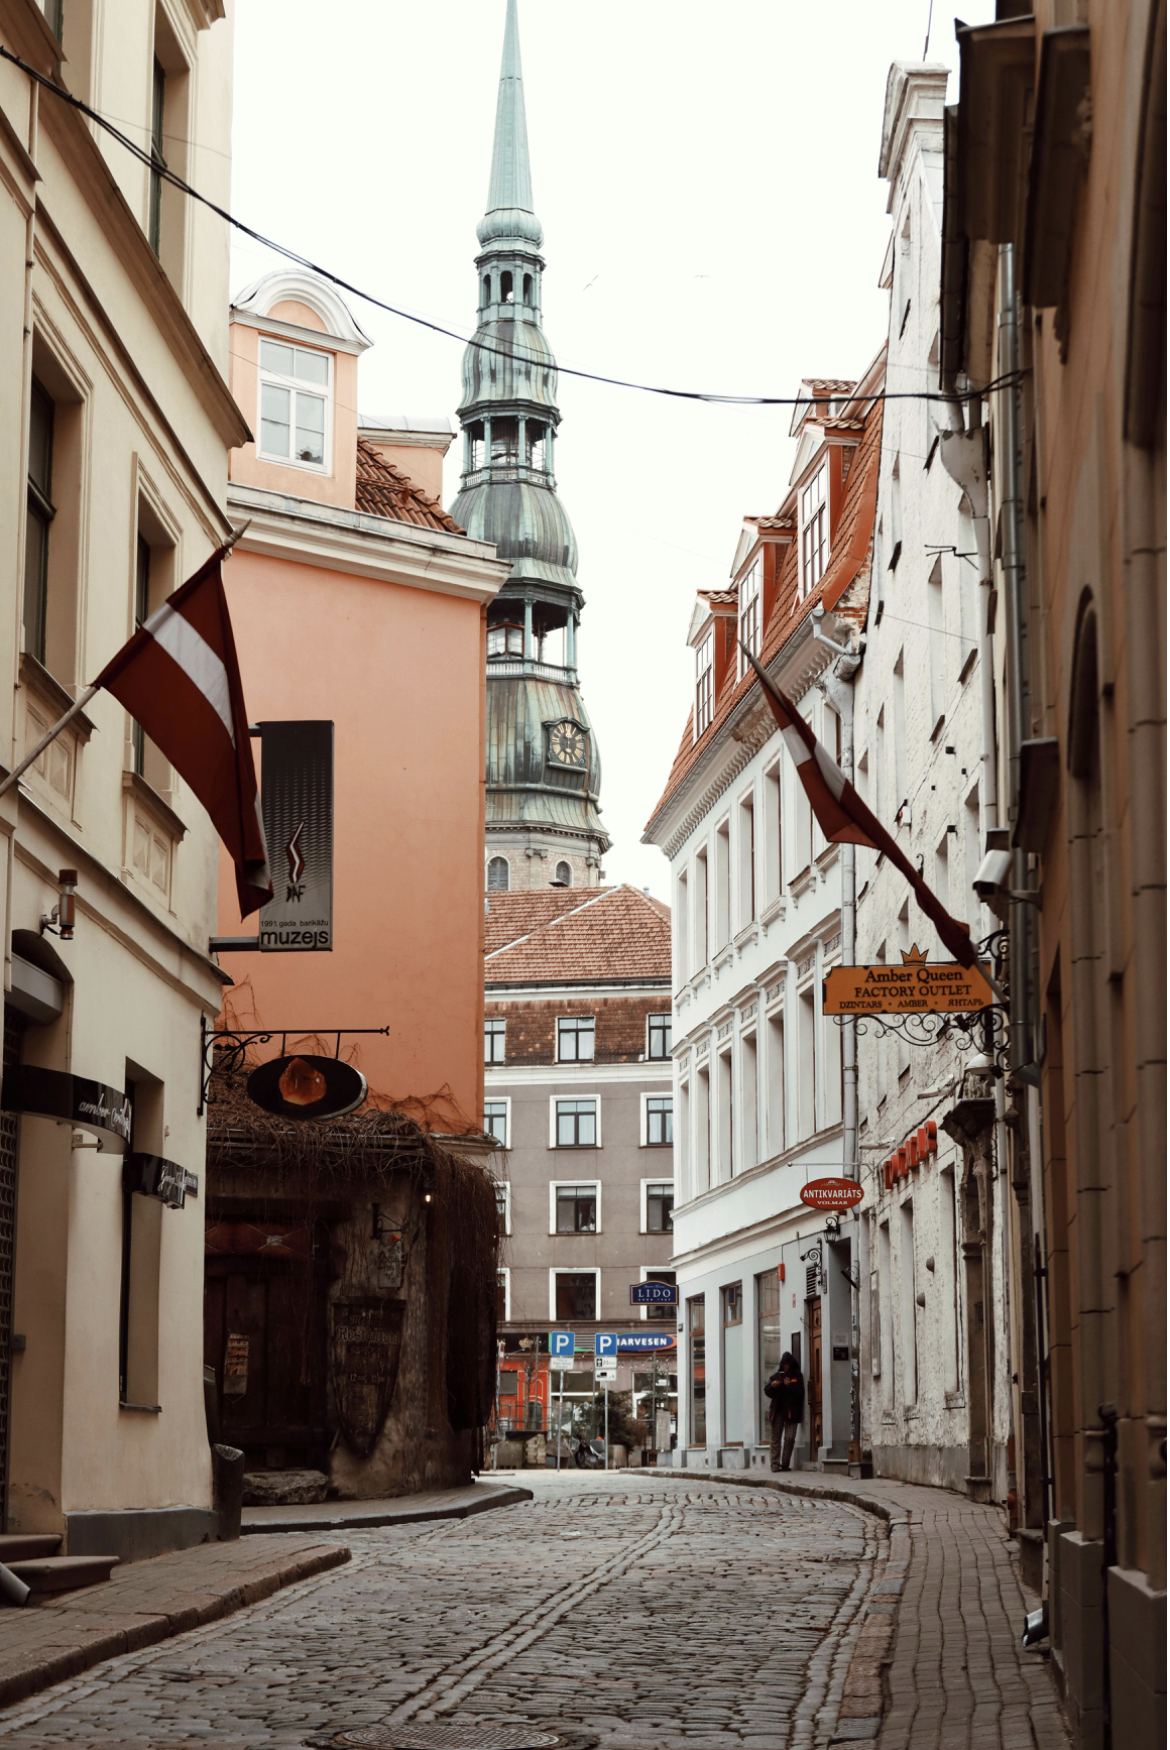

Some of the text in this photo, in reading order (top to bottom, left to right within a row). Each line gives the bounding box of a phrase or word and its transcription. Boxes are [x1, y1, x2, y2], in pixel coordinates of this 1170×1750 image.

[278, 920, 297, 929] gada
[260, 930, 329, 949] muzejs
[864, 967, 964, 984] Amber Queen
[854, 984, 972, 998] FACTORY OUTLET
[839, 999, 929, 1010] DZINTARS AMBER
[947, 997, 984, 1007] ЯНТАРЬ
[79, 1093, 111, 1118] amber
[803, 1187, 862, 1199] ANTIKVARIĀTS
[638, 1289, 671, 1298] LIDO
[556, 1334, 570, 1354] P
[599, 1335, 612, 1354] P
